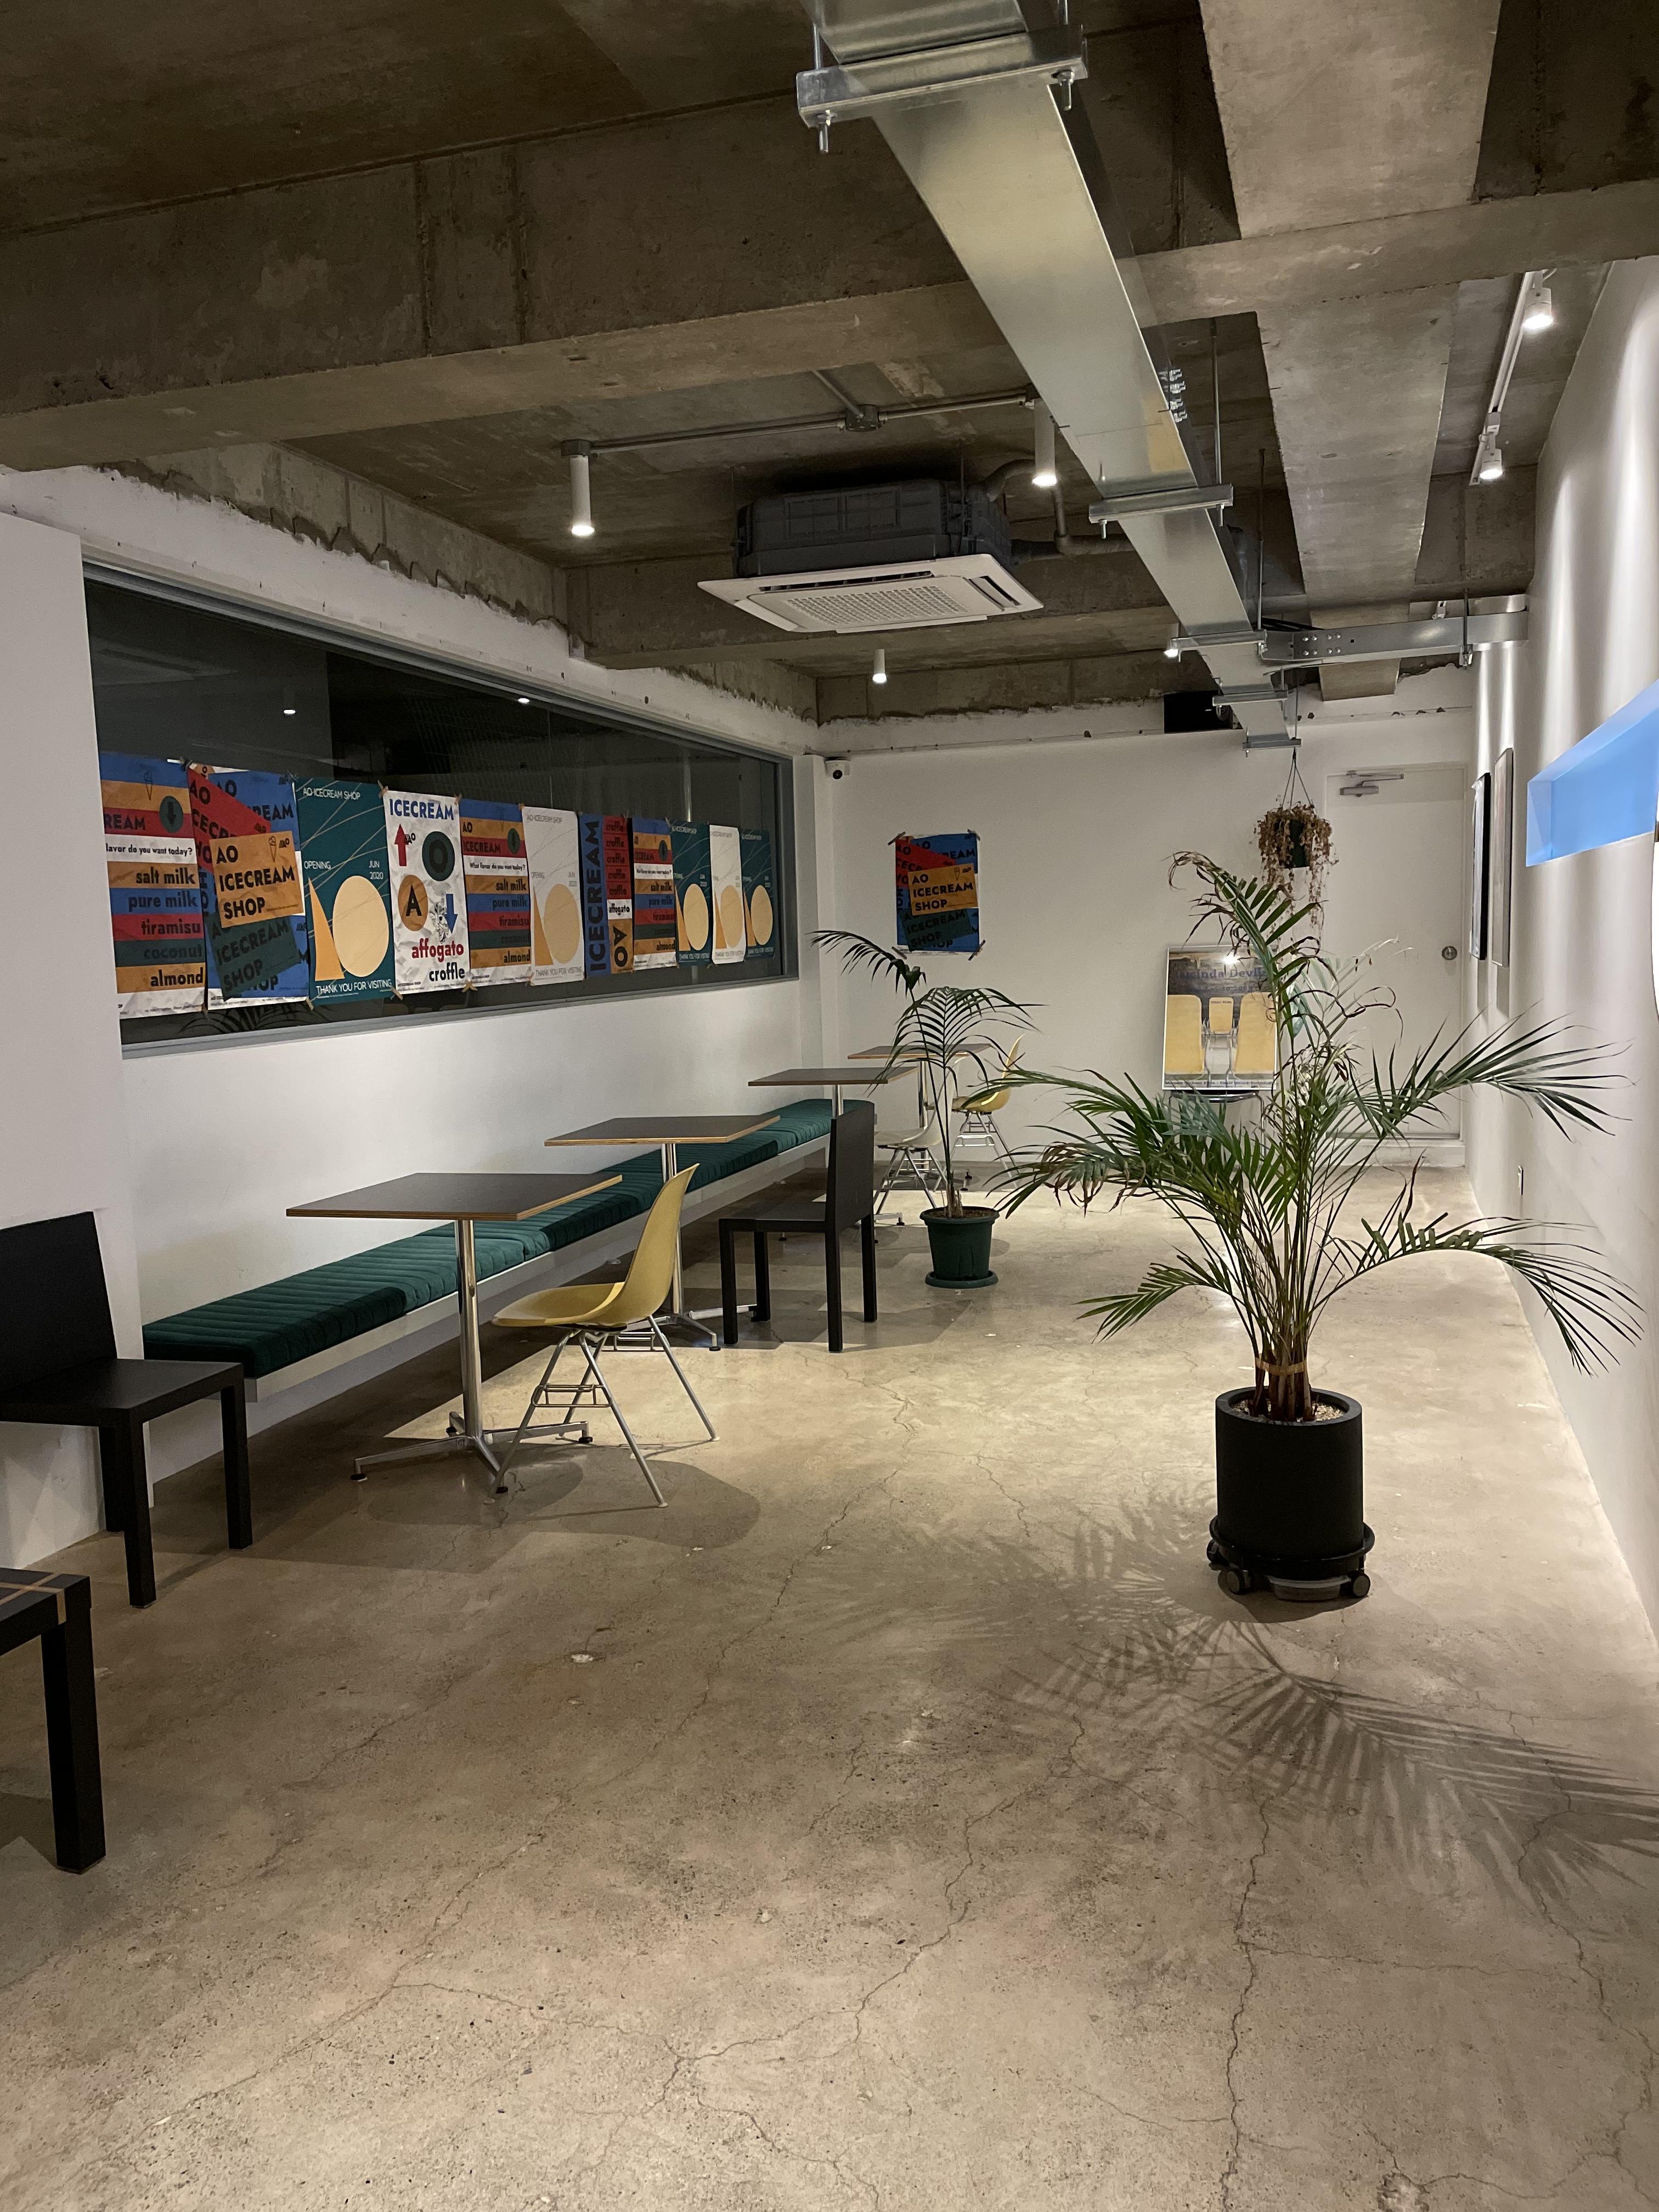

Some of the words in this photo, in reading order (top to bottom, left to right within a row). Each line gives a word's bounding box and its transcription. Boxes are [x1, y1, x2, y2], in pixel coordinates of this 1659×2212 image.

[190, 780, 211, 805] AO
[343, 791, 361, 800] SHOP
[390, 799, 454, 820] ICECREAM
[104, 814, 145, 830] REAM
[462, 822, 473, 833] AO
[106, 843, 126, 852] lavor
[128, 844, 137, 853] do
[168, 847, 193, 856] today?
[216, 845, 238, 864] AO
[464, 840, 501, 853] ICECREAM
[303, 861, 331, 870] OPENING
[136, 866, 159, 884] salt
[163, 867, 196, 884] milk
[219, 865, 295, 891] ICECREAM
[912, 874, 929, 884] AO
[496, 878, 509, 891] salt
[510, 878, 527, 891] milk
[913, 882, 973, 898] ICECREAM
[128, 896, 161, 912] pure
[166, 890, 198, 907] milk
[406, 885, 422, 916] A
[492, 899, 510, 910] pure
[512, 895, 527, 907] milk
[585, 821, 606, 971] ICECREAM
[223, 897, 265, 919] SHOP
[609, 904, 630, 915] affogato
[915, 899, 947, 911] SHOP
[141, 918, 200, 934] tiramisu
[499, 915, 529, 926] tiramisu
[217, 919, 287, 965] ICECREAM
[411, 938, 464, 962] affogato
[613, 926, 628, 967] AO
[144, 944, 202, 959] coconut
[504, 950, 531, 963] almond
[150, 967, 204, 986] almond
[223, 959, 263, 992] SHOP
[429, 962, 465, 981] croffle
[316, 984, 338, 994] THANK
[338, 983, 353, 992] YOU
[354, 981, 366, 990] FOR
[368, 979, 392, 989] VISITING
